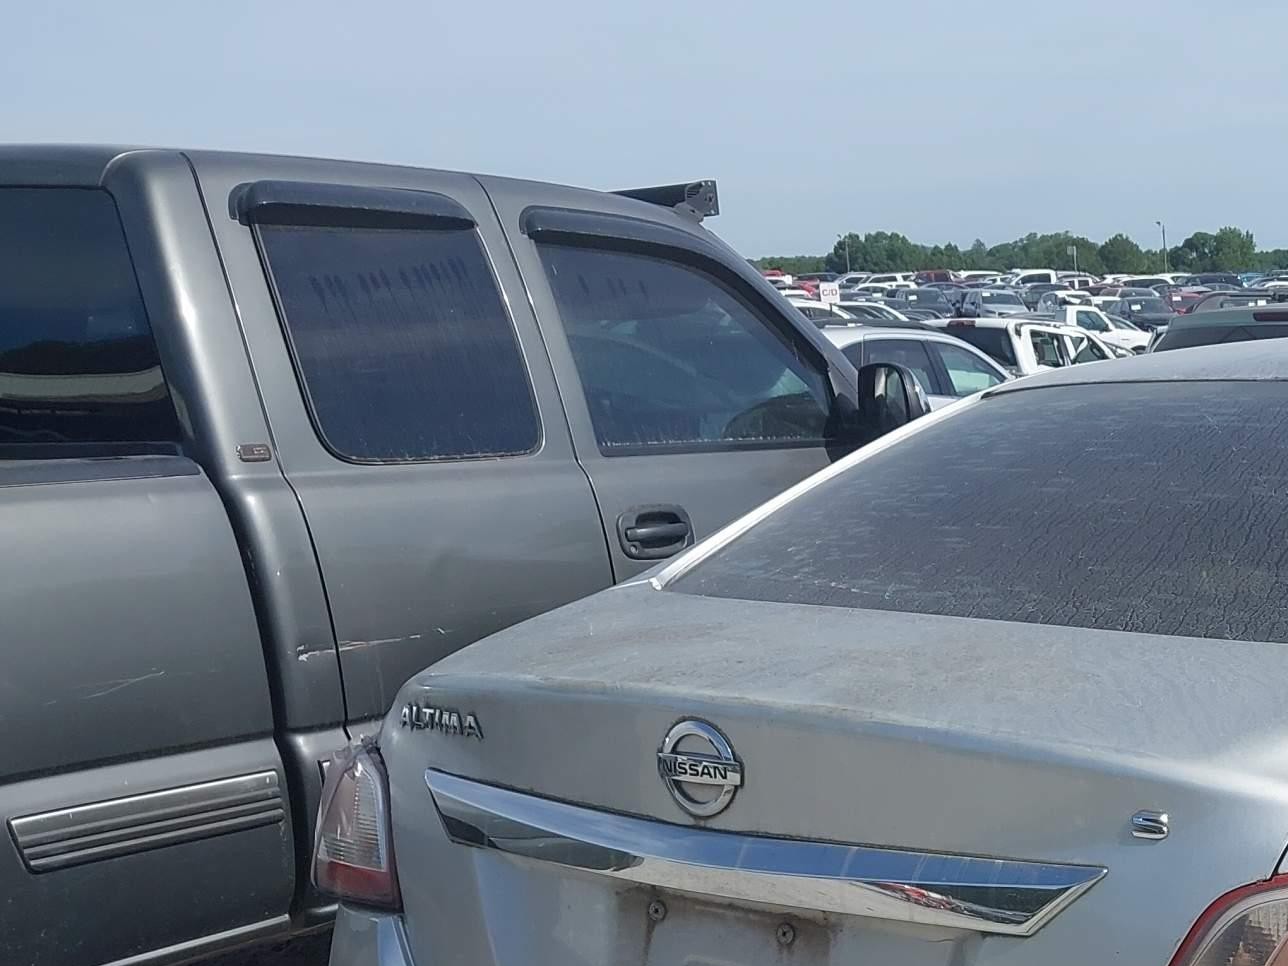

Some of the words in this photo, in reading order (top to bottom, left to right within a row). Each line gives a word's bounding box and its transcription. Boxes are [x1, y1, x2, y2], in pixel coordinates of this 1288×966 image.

[822, 289, 838, 297] C/D
[400, 704, 484, 741] ALTIMA
[662, 758, 728, 780] NISSAN
